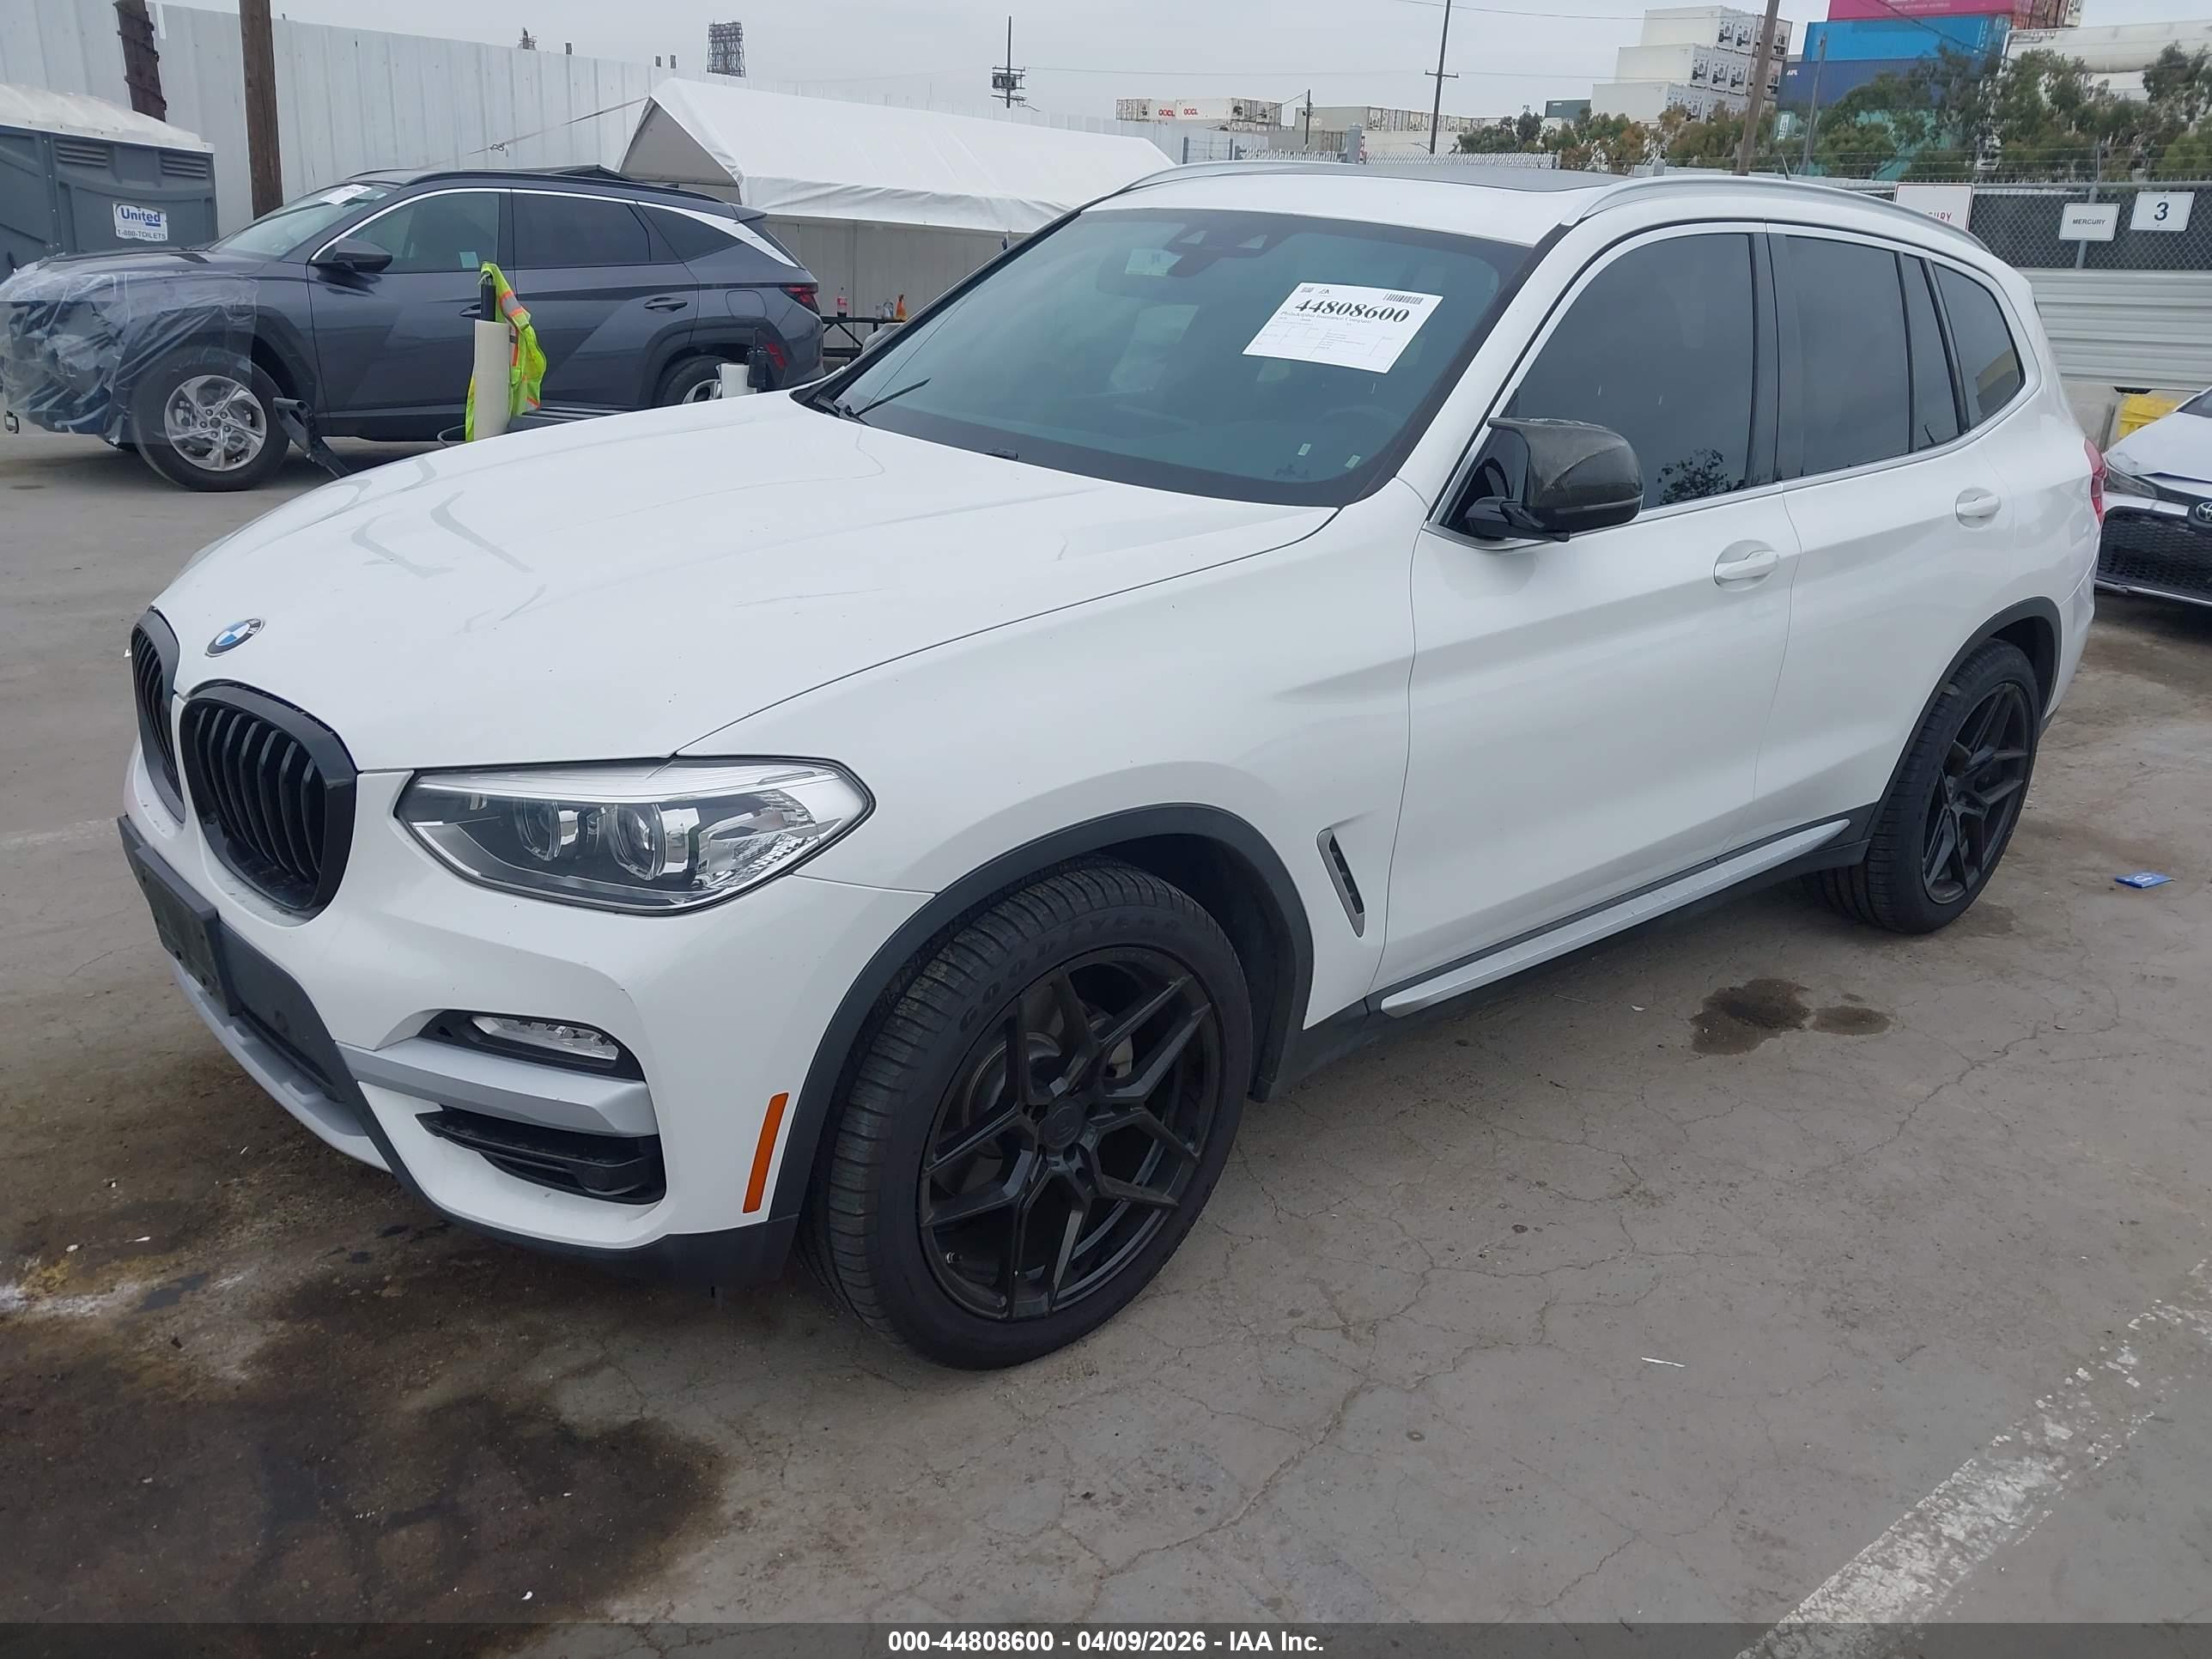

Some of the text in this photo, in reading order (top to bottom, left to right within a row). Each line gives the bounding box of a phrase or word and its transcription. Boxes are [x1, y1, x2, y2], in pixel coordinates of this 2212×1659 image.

[1158, 109, 1176, 118] OOCL
[120, 207, 161, 222] United
[2154, 201, 2169, 222] 3
[1295, 298, 1410, 324] 44808600
